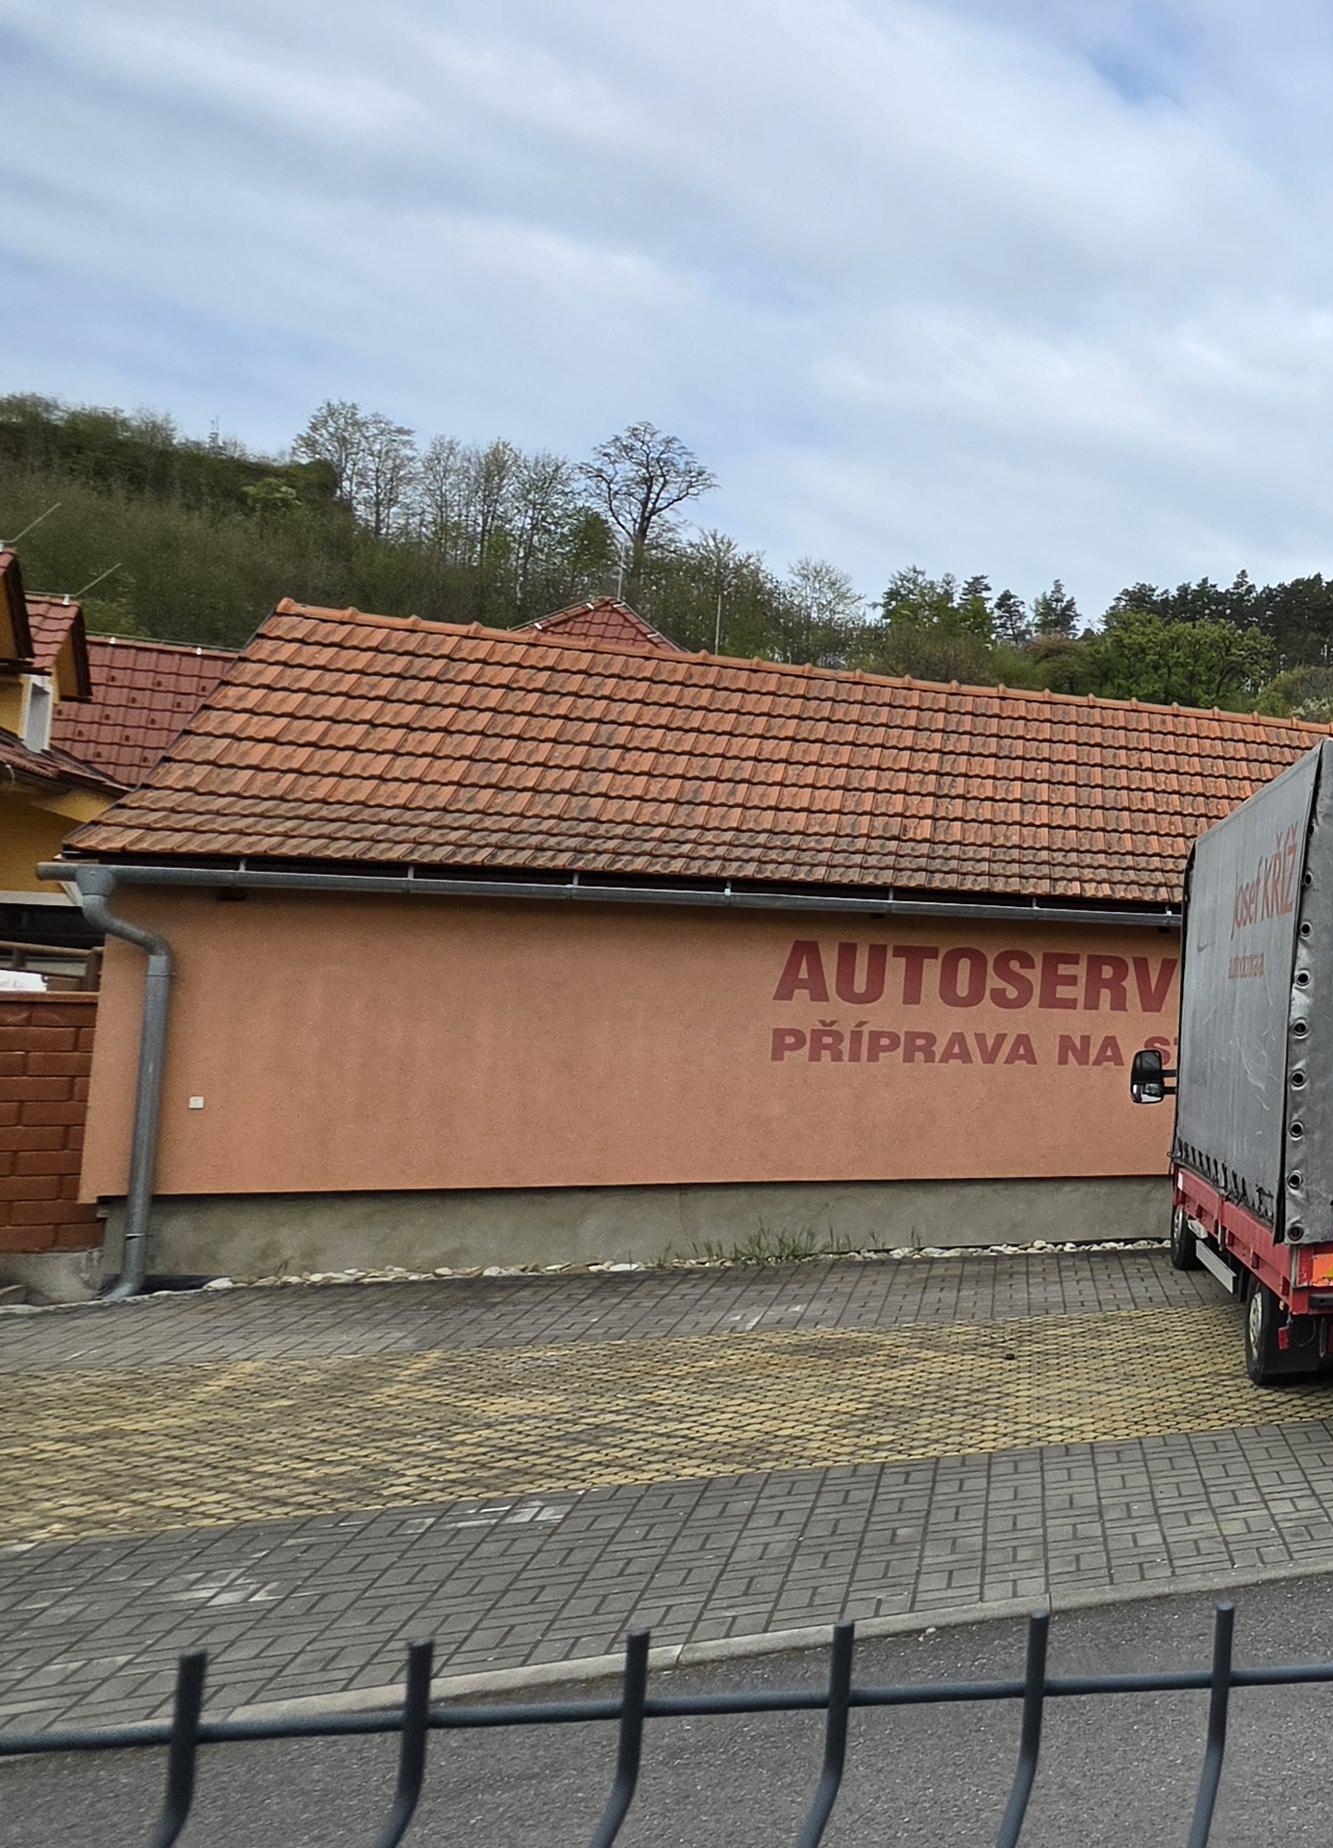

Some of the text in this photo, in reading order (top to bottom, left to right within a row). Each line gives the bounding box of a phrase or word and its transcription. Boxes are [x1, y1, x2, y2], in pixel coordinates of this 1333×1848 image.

[1230, 821, 1298, 941] Josef KŘÍŽ
[769, 1019, 1039, 1067] PŘÍPRAVA
[1057, 1035, 1126, 1068] NA
